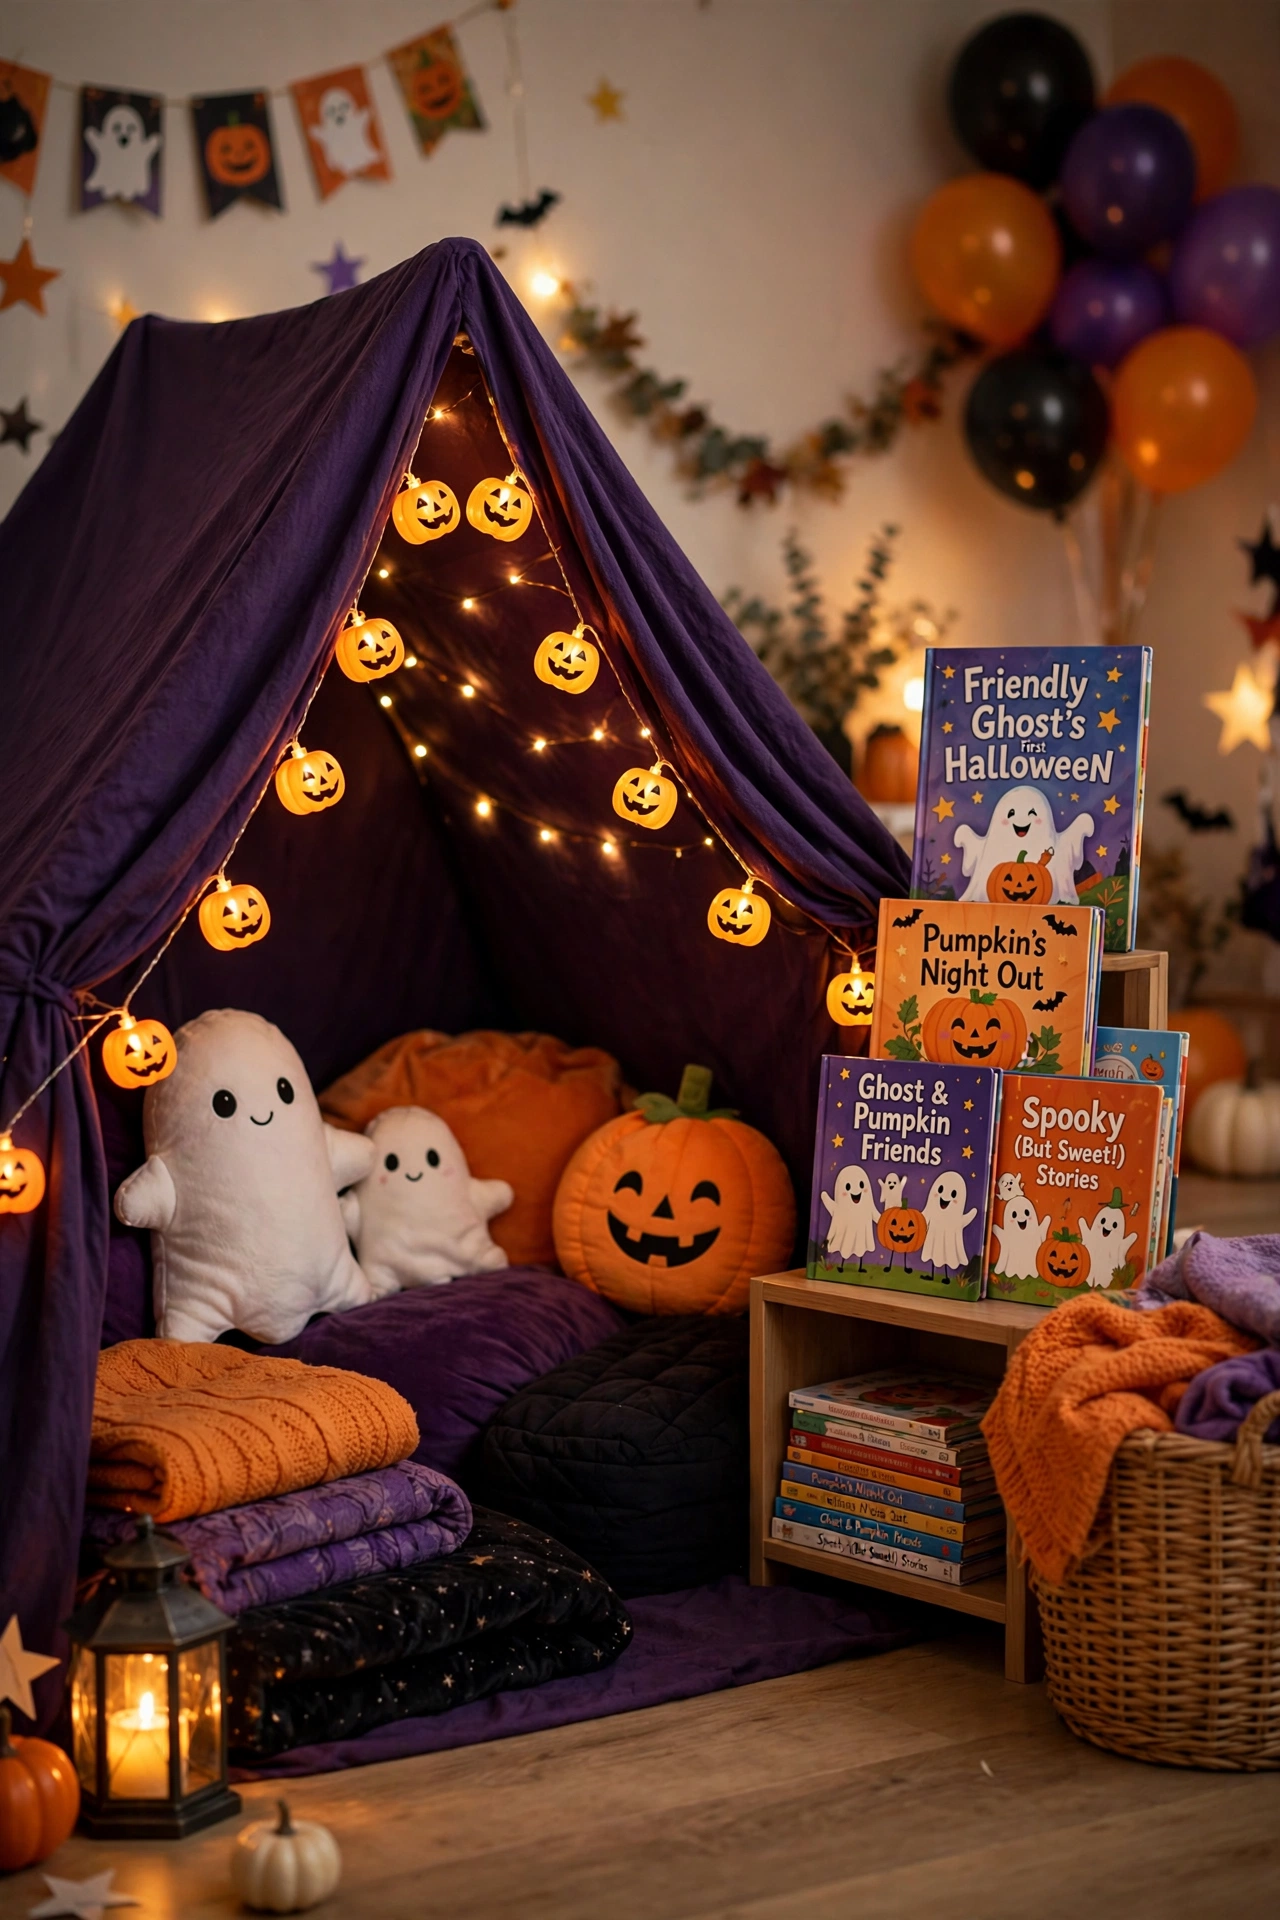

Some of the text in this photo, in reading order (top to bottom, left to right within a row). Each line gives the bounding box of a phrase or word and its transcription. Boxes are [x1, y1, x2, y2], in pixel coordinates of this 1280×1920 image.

[964, 663, 1089, 709] Friendly
[971, 704, 1086, 740] Ghost's
[1020, 740, 1047, 753] First
[923, 923, 1047, 958] Pumpkin's
[920, 957, 1045, 994] Night Out
[858, 1072, 950, 1106] Ghost &
[853, 1101, 951, 1136] Pumpkin
[1021, 1096, 1126, 1143] Spooky
[860, 1133, 942, 1167] Friends
[1014, 1135, 1126, 1169] (But Sweet!)
[1036, 1163, 1099, 1190] Stories
